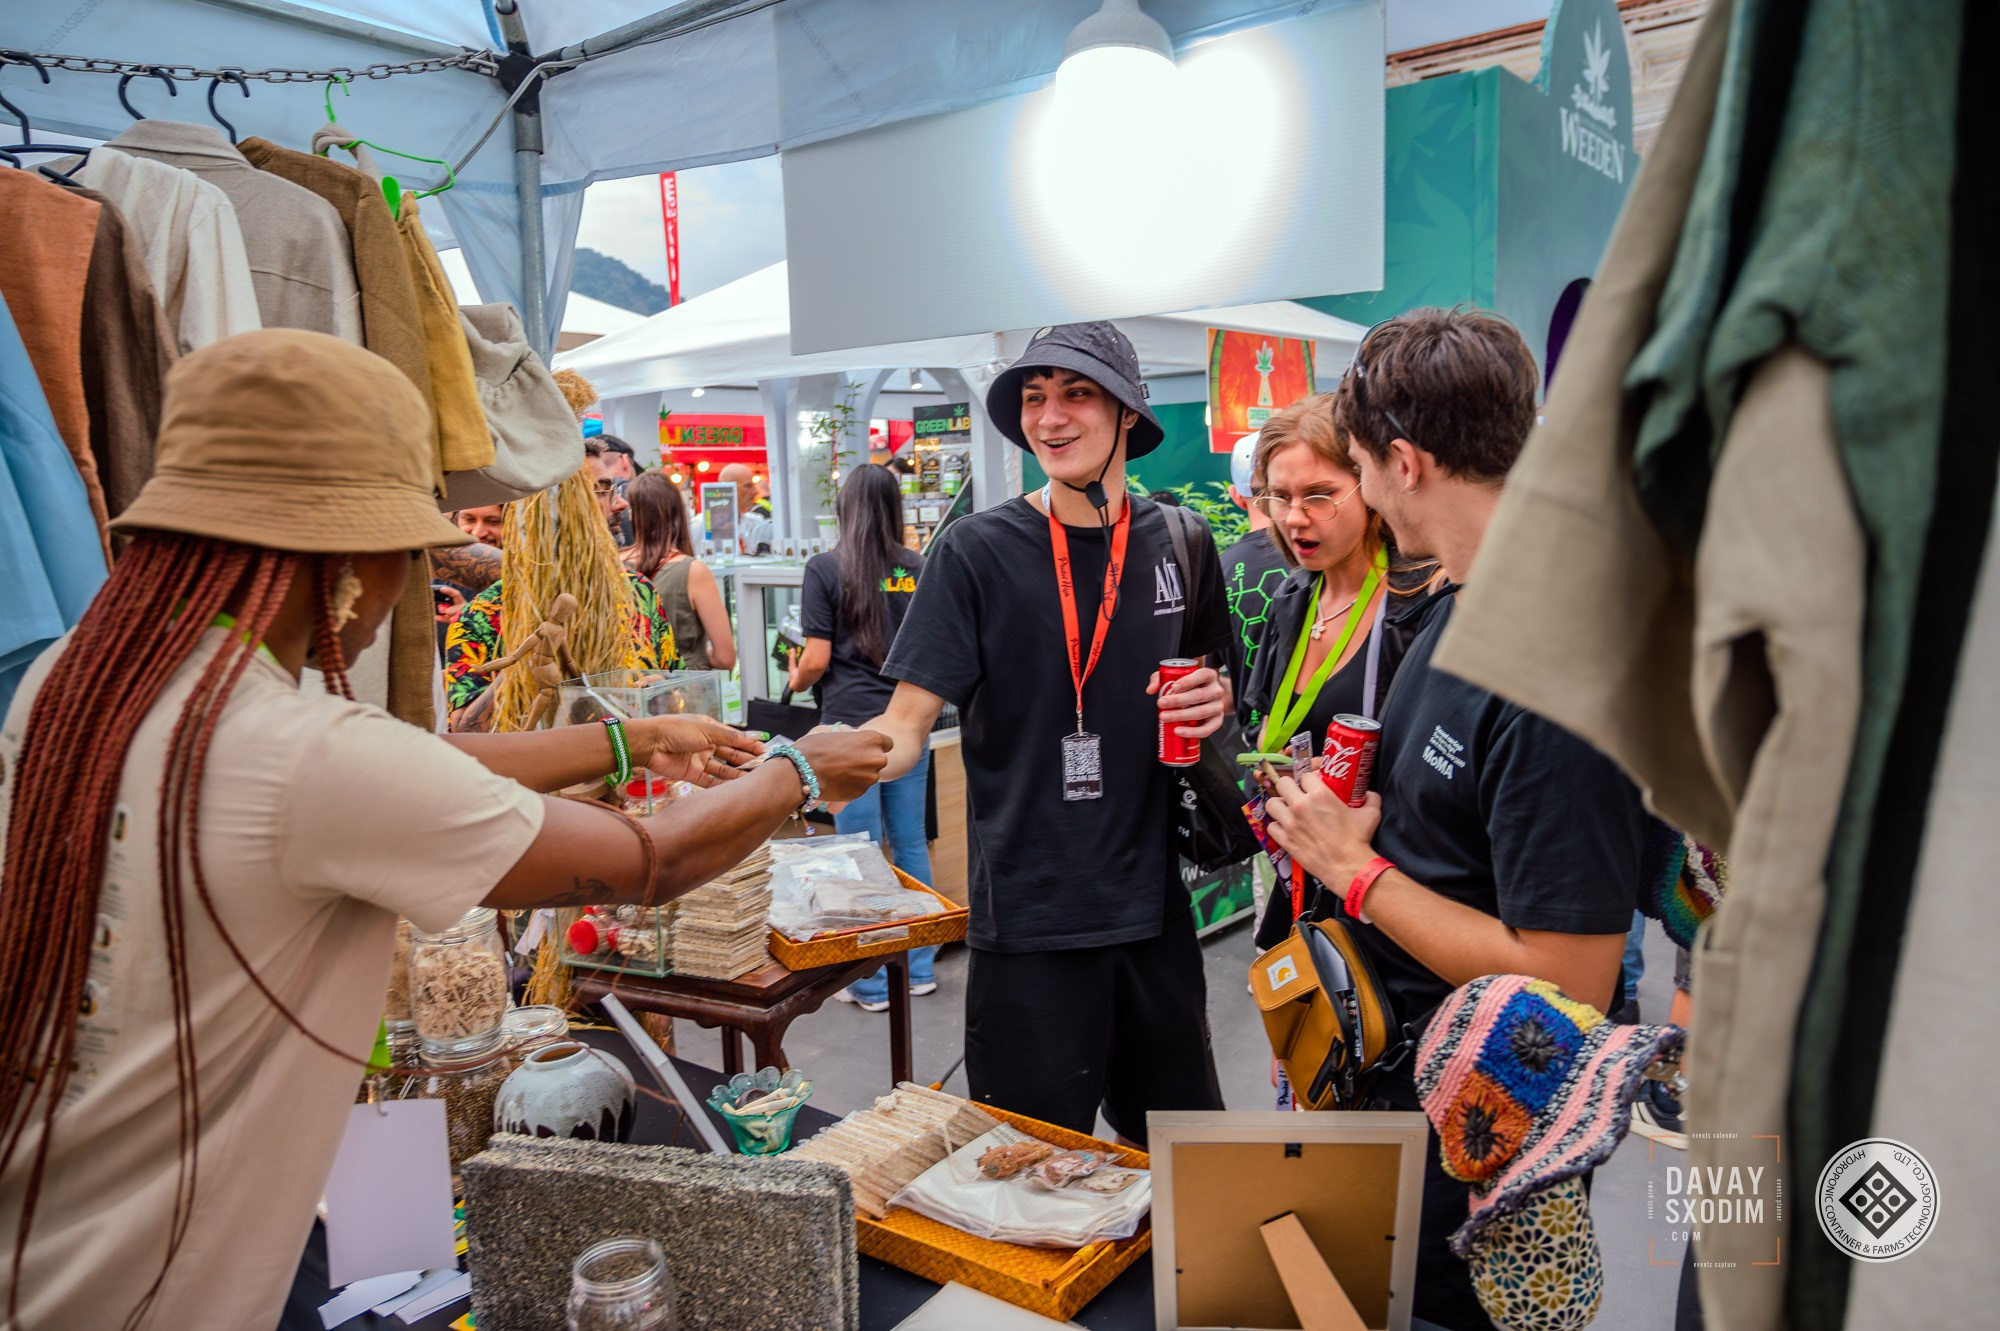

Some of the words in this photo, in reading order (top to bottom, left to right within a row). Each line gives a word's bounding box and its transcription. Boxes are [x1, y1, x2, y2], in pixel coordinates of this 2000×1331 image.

[1559, 106, 1626, 185] WEEDEN
[915, 416, 971, 434] GREENLAB
[1421, 744, 1455, 780] MoMA
